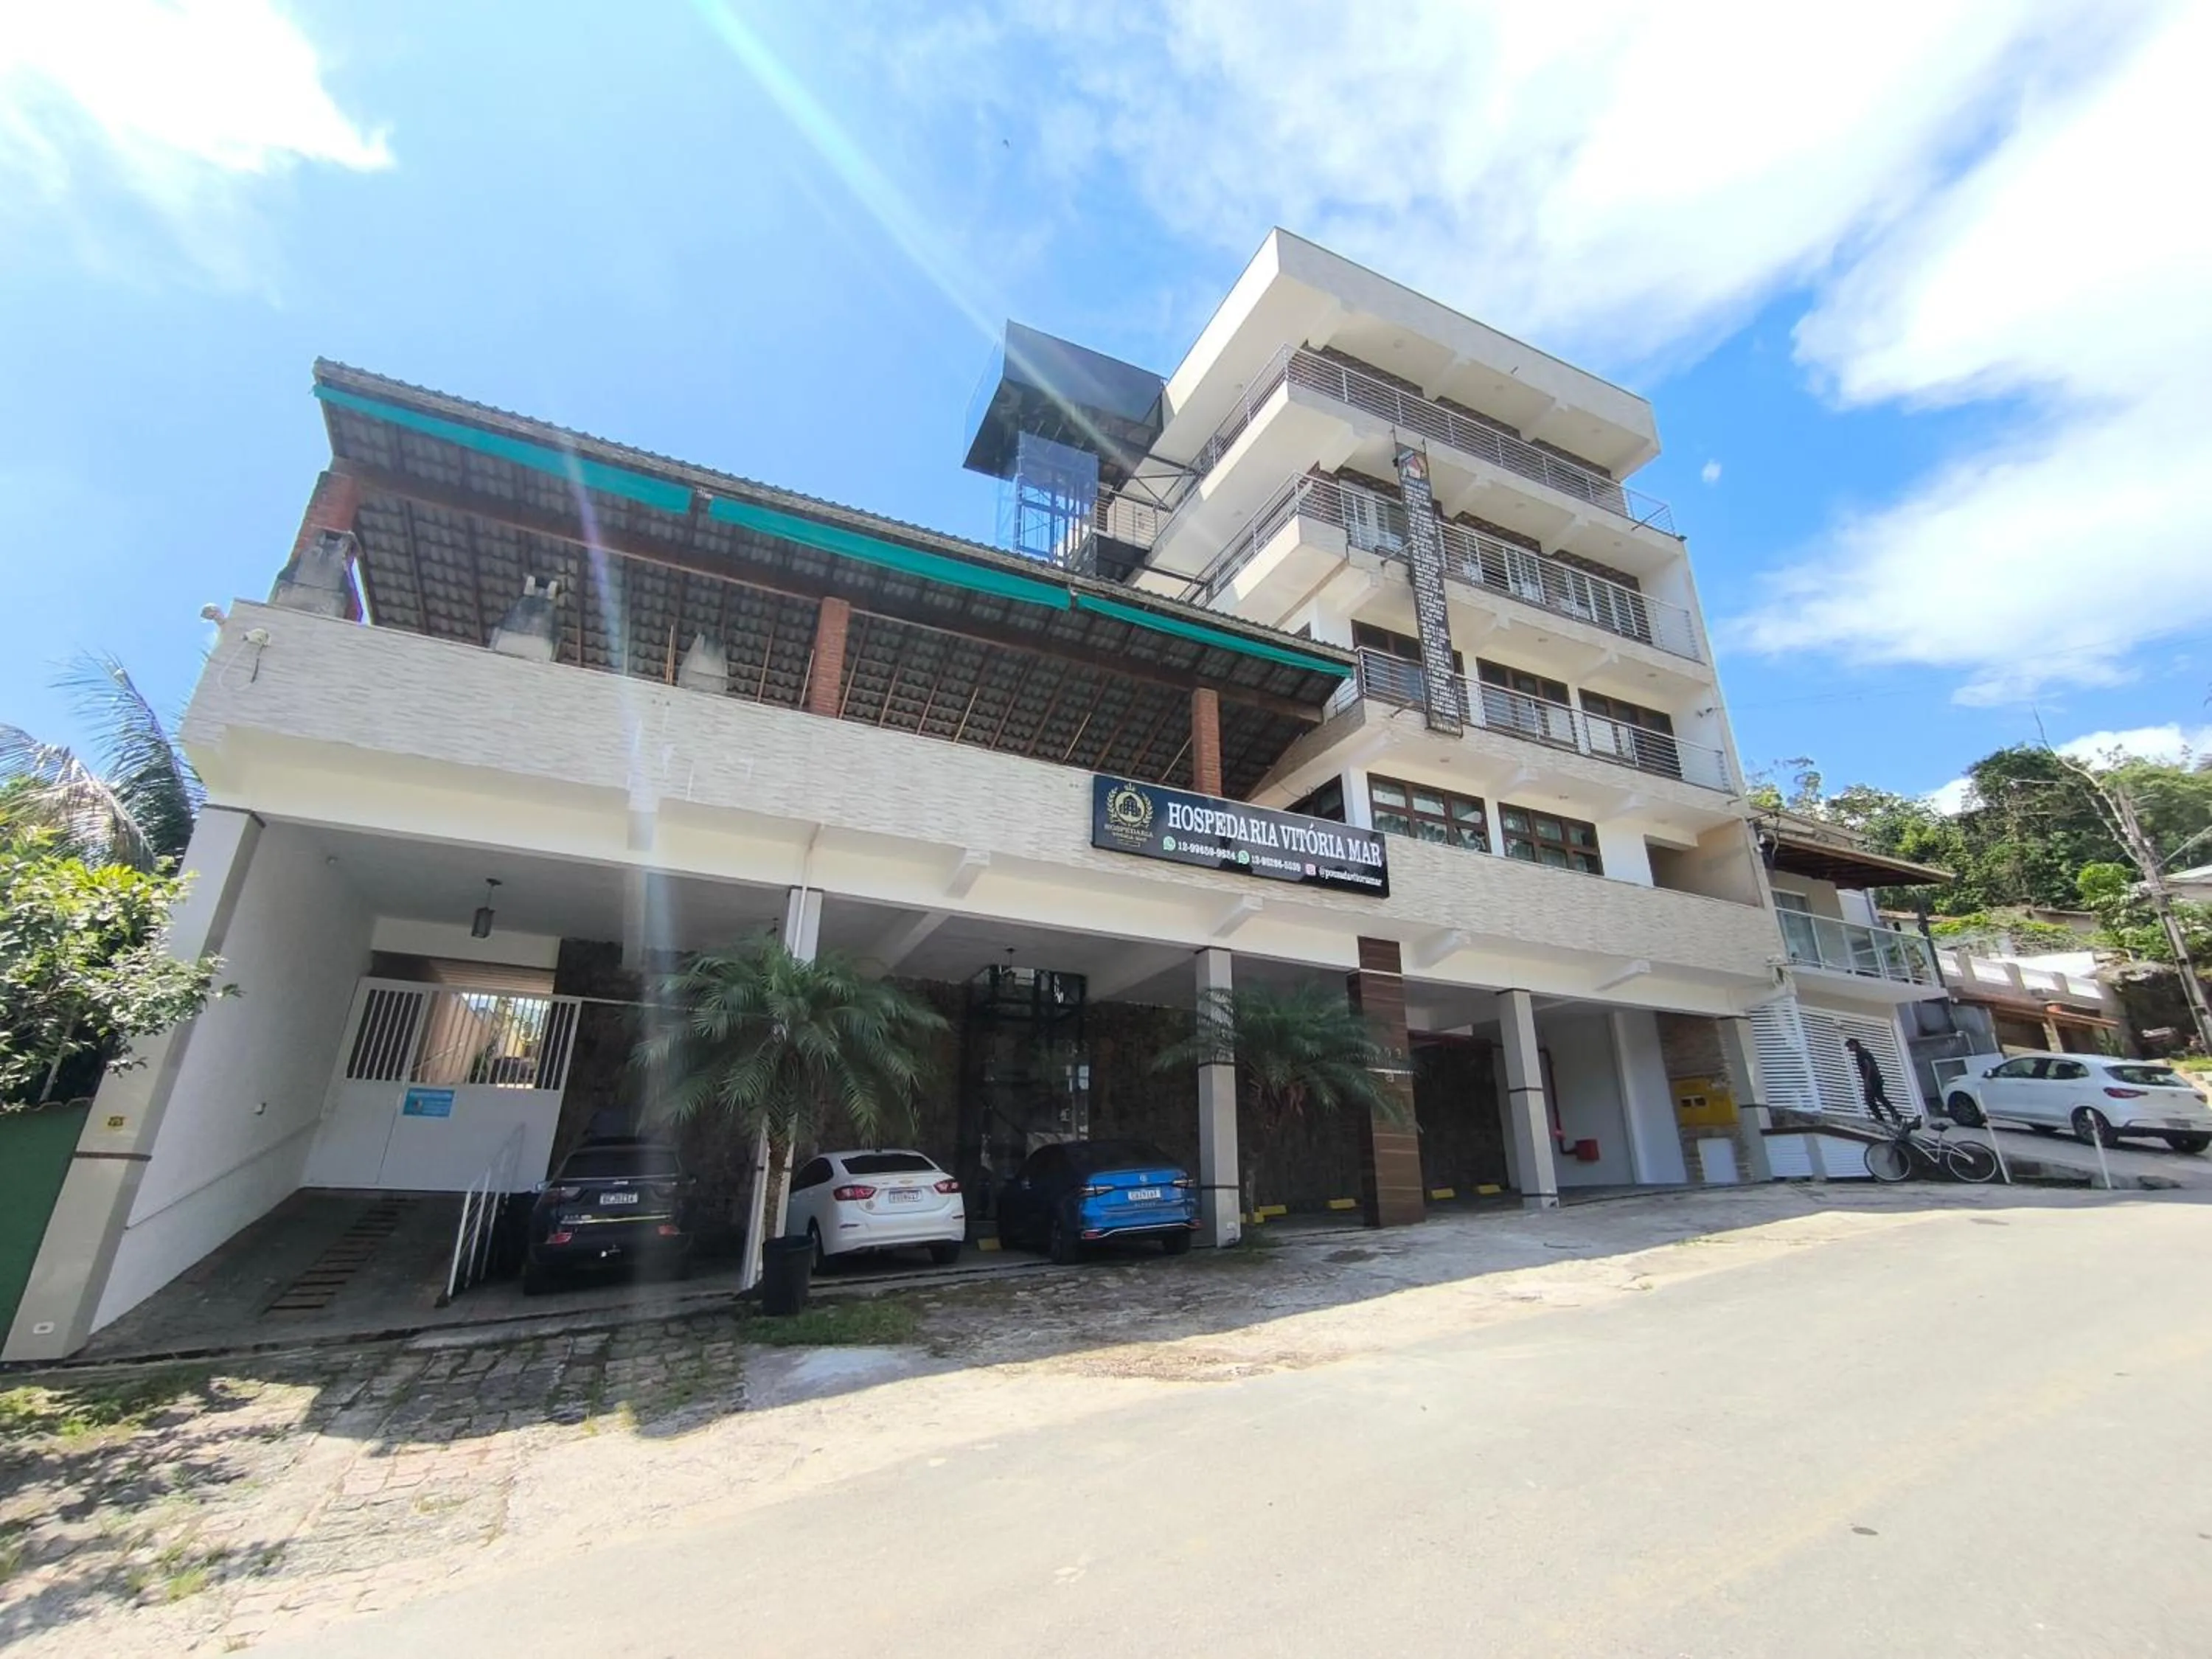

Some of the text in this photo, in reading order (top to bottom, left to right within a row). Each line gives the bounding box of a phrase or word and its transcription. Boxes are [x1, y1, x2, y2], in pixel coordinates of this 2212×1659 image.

[1167, 801, 1382, 867] HOSPEDARIA VITÓRIA MAR
